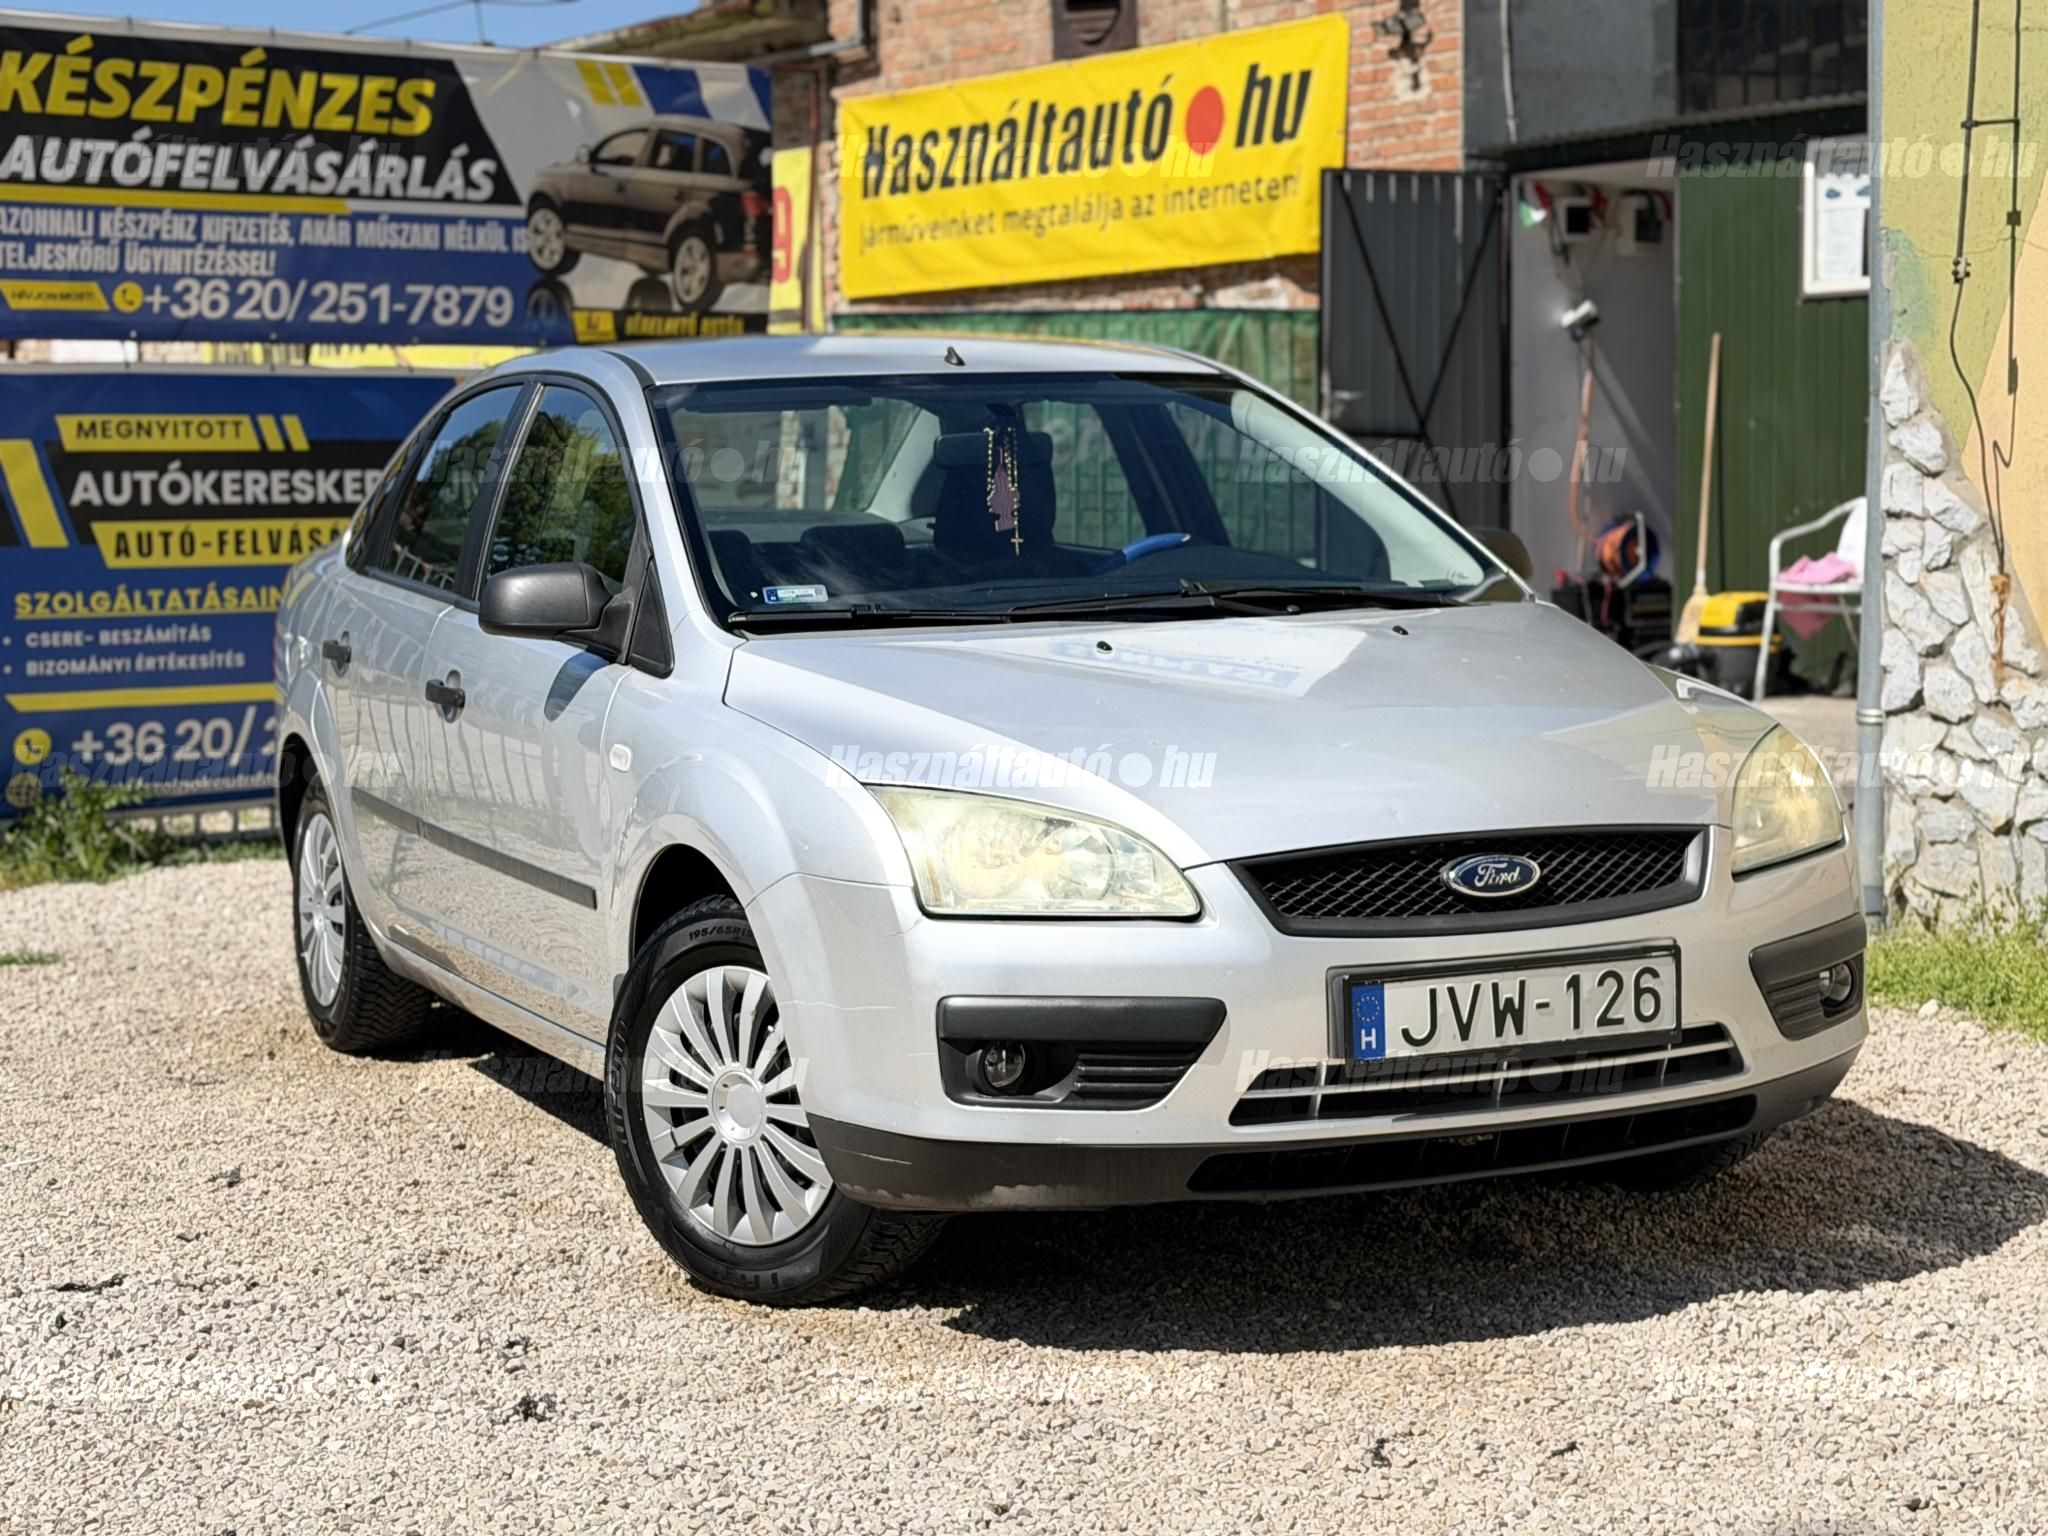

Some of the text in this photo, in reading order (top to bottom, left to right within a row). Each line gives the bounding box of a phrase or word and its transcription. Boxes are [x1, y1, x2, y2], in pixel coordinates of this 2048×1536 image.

[0, 34, 437, 137] KÉSZPÉNZES
[861, 62, 1313, 199] Használtautó hu
[0, 126, 498, 201] AUTÓFELVÁSÁRLÁS
[0, 207, 95, 239] AZONNALI
[100, 206, 198, 242] KÉSZPÉNZ
[202, 212, 295, 247] KIFIZETÉS,
[300, 215, 351, 247] AKÁR
[356, 215, 440, 250] MŰSZAKI
[444, 219, 509, 253] NÉLKÜL
[1002, 190, 1123, 239] megtalálja
[1131, 191, 1156, 218] az
[0, 238, 277, 277] TELJESKÖRŰ ÜGYINTÉZÉSSEL!
[76, 419, 244, 440] MEGNYITOTT
[25, 622, 213, 649] CSERE- BESZÁMÍTÁS
[26, 649, 247, 677] BIZOMÁNYI ÉRTÉKESÍTÉS
[1474, 861, 1522, 889] Ford
[1360, 965, 1663, 1051] H JVW-126
